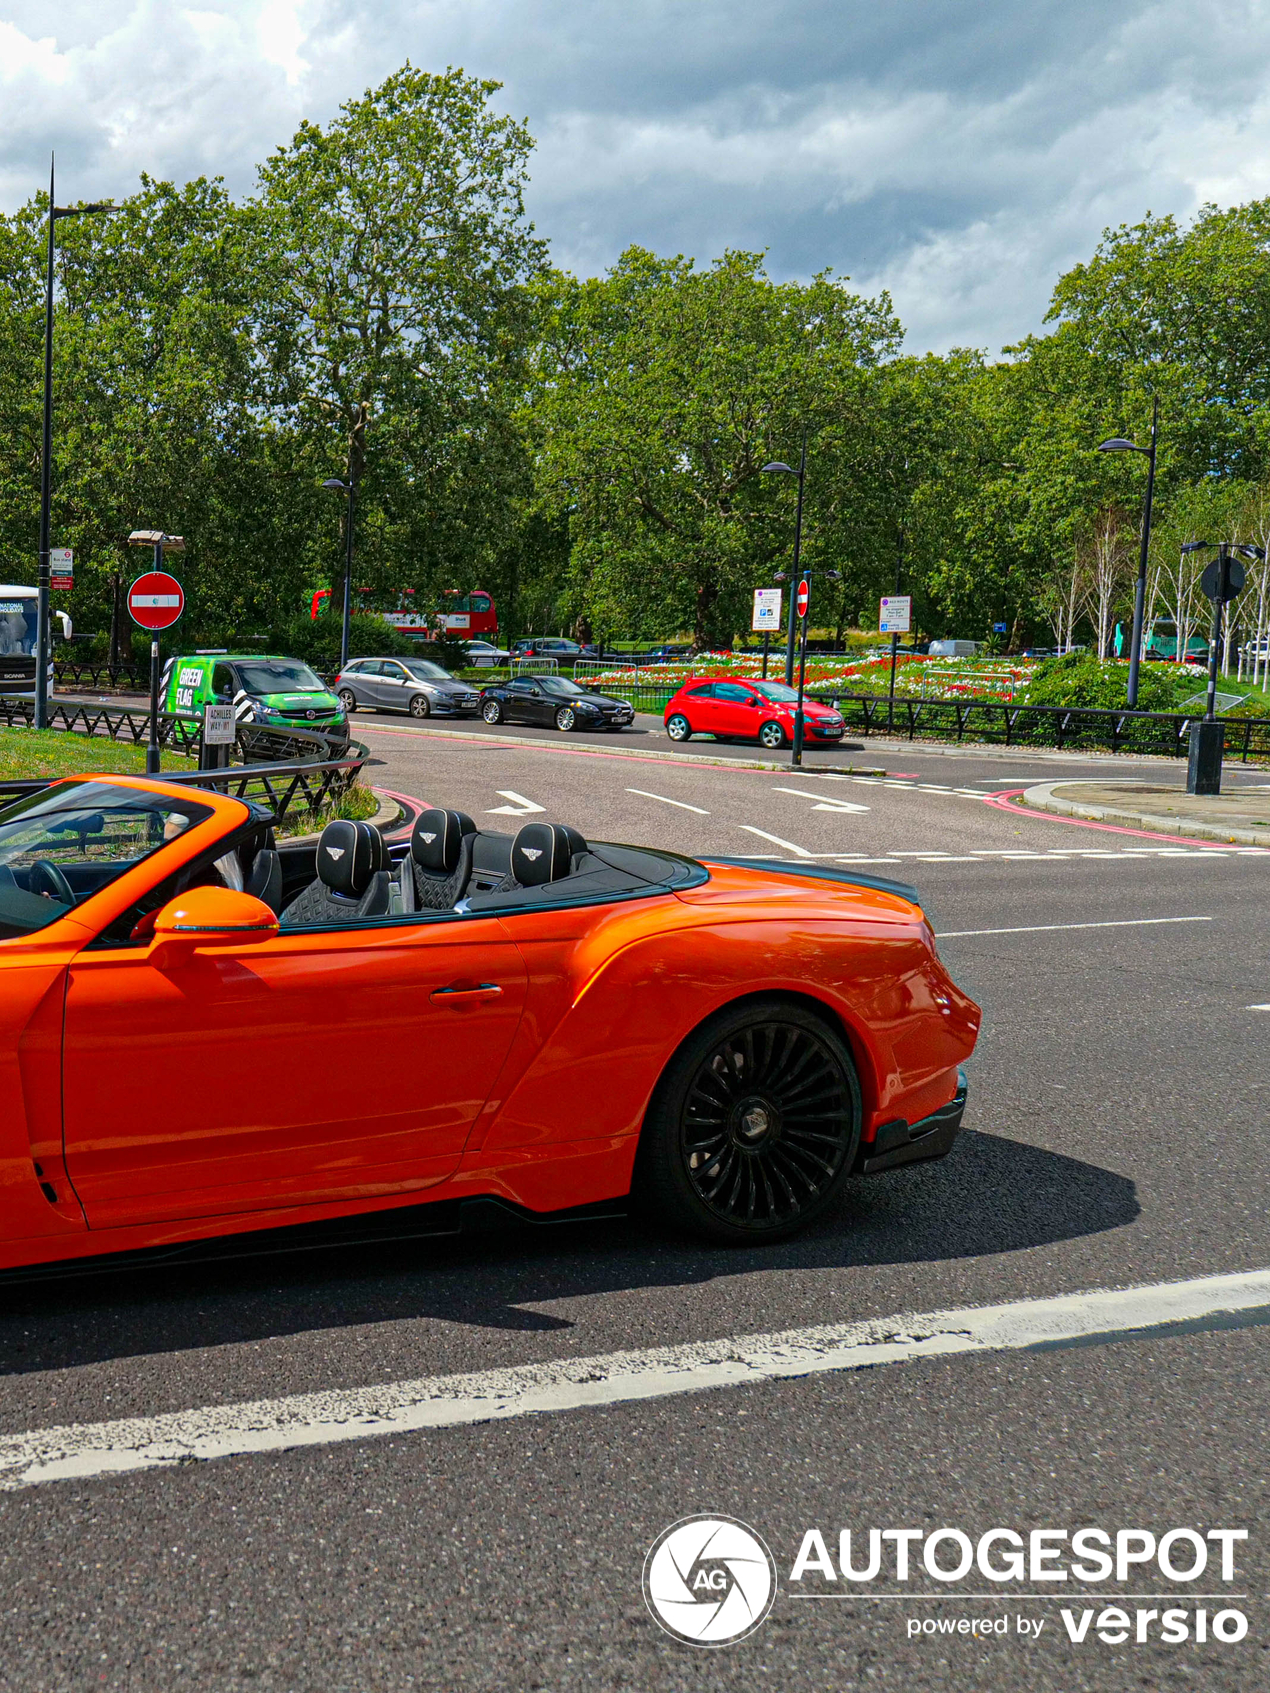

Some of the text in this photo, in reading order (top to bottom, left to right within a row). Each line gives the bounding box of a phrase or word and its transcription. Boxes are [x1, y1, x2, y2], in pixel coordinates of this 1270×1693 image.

[179, 668, 204, 687] GREEN
[176, 688, 193, 707] FLAG
[210, 709, 232, 720] ACHILLES
[210, 721, 222, 731] WAY
